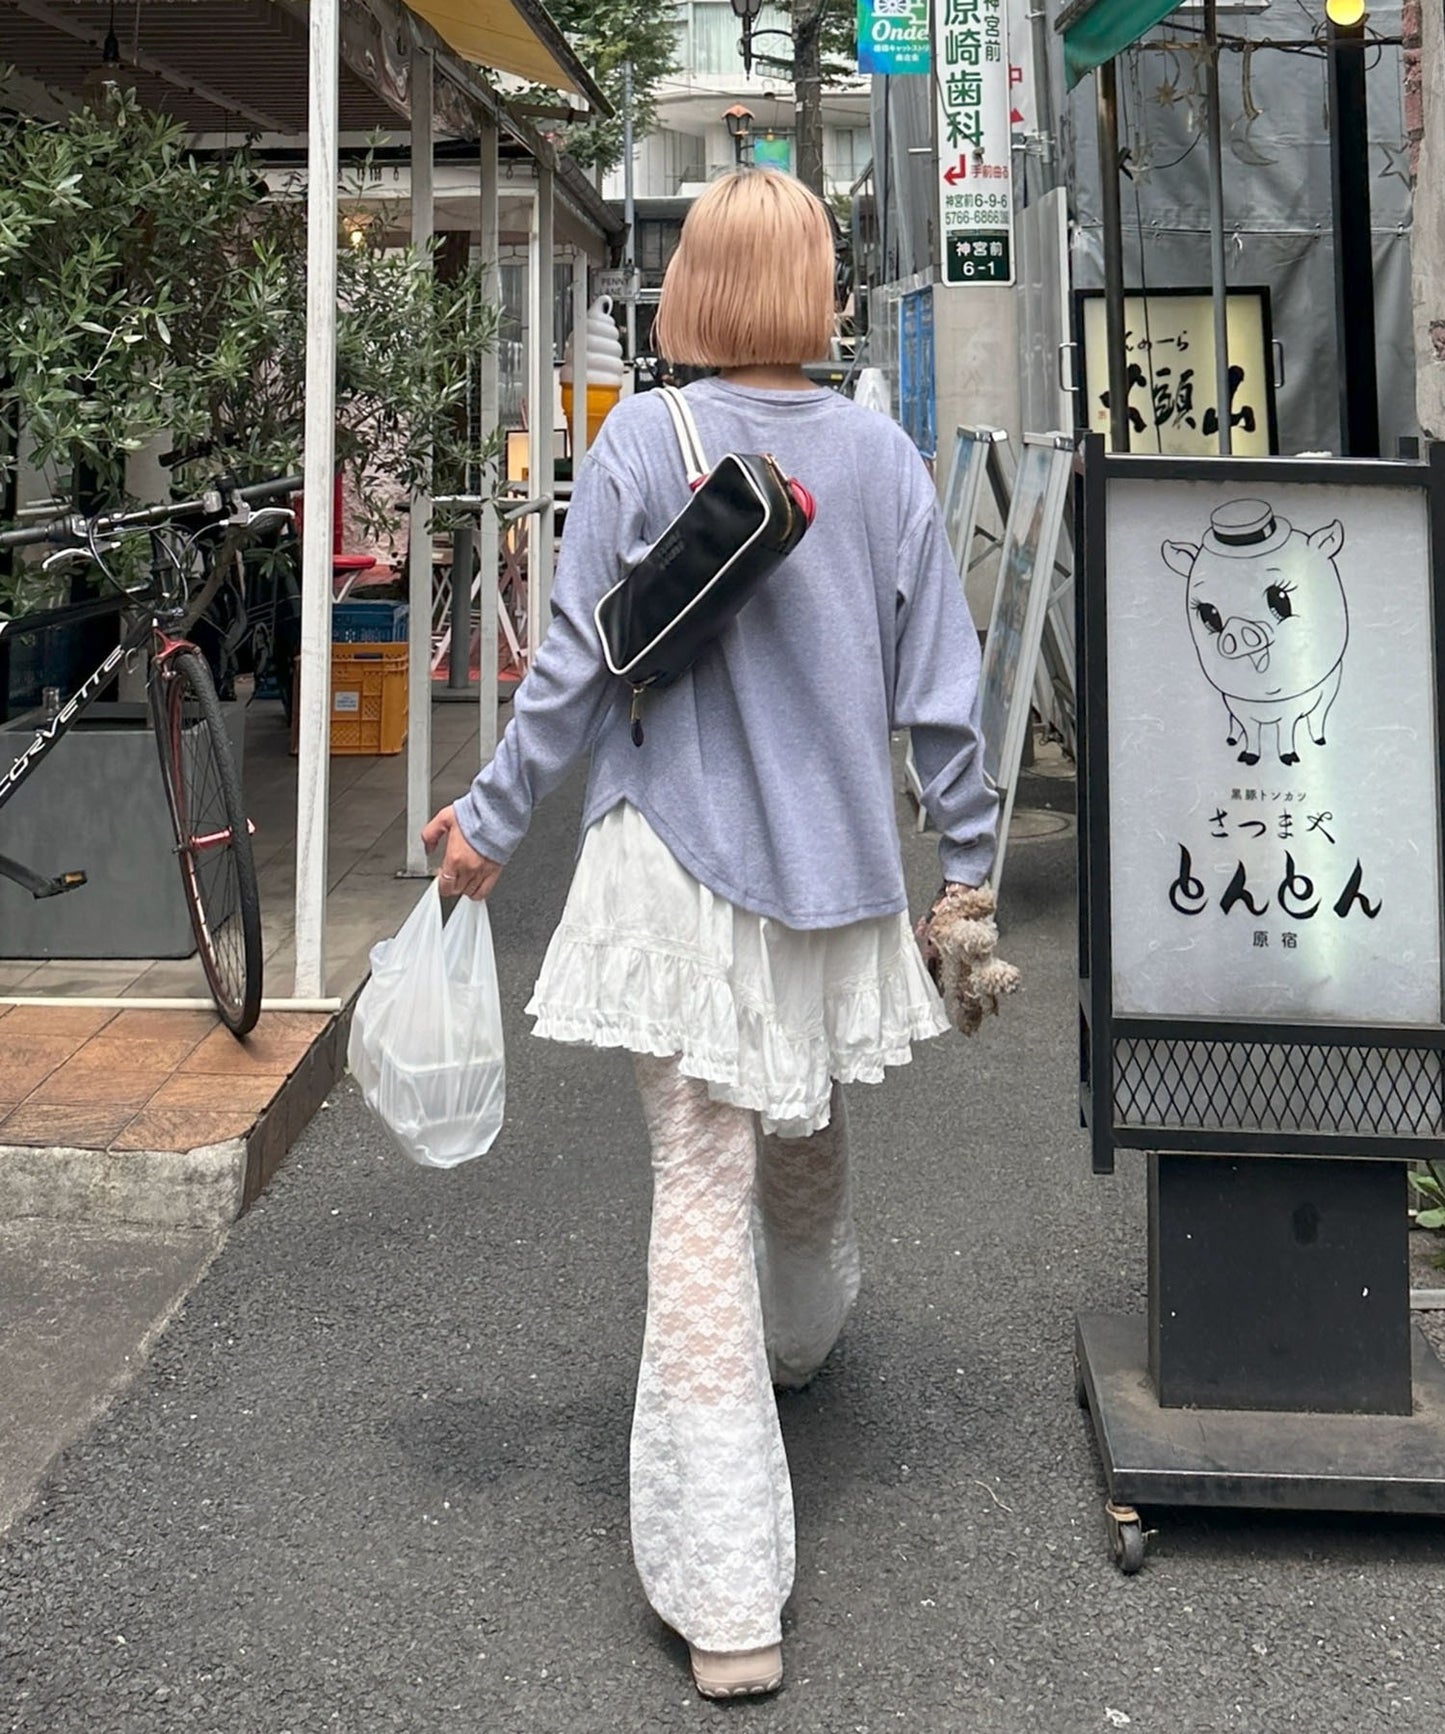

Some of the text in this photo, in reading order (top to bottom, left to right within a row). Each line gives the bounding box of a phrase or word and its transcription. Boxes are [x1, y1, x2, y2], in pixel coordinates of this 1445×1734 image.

[955, 241, 1003, 257] 神宮前
[962, 260, 996, 276] 6-1
[1230, 788, 1307, 803] 黒豚トンカツ
[1208, 806, 1336, 845] さつまや
[1168, 841, 1384, 920] とんとん
[1252, 930, 1298, 949] 原宿
